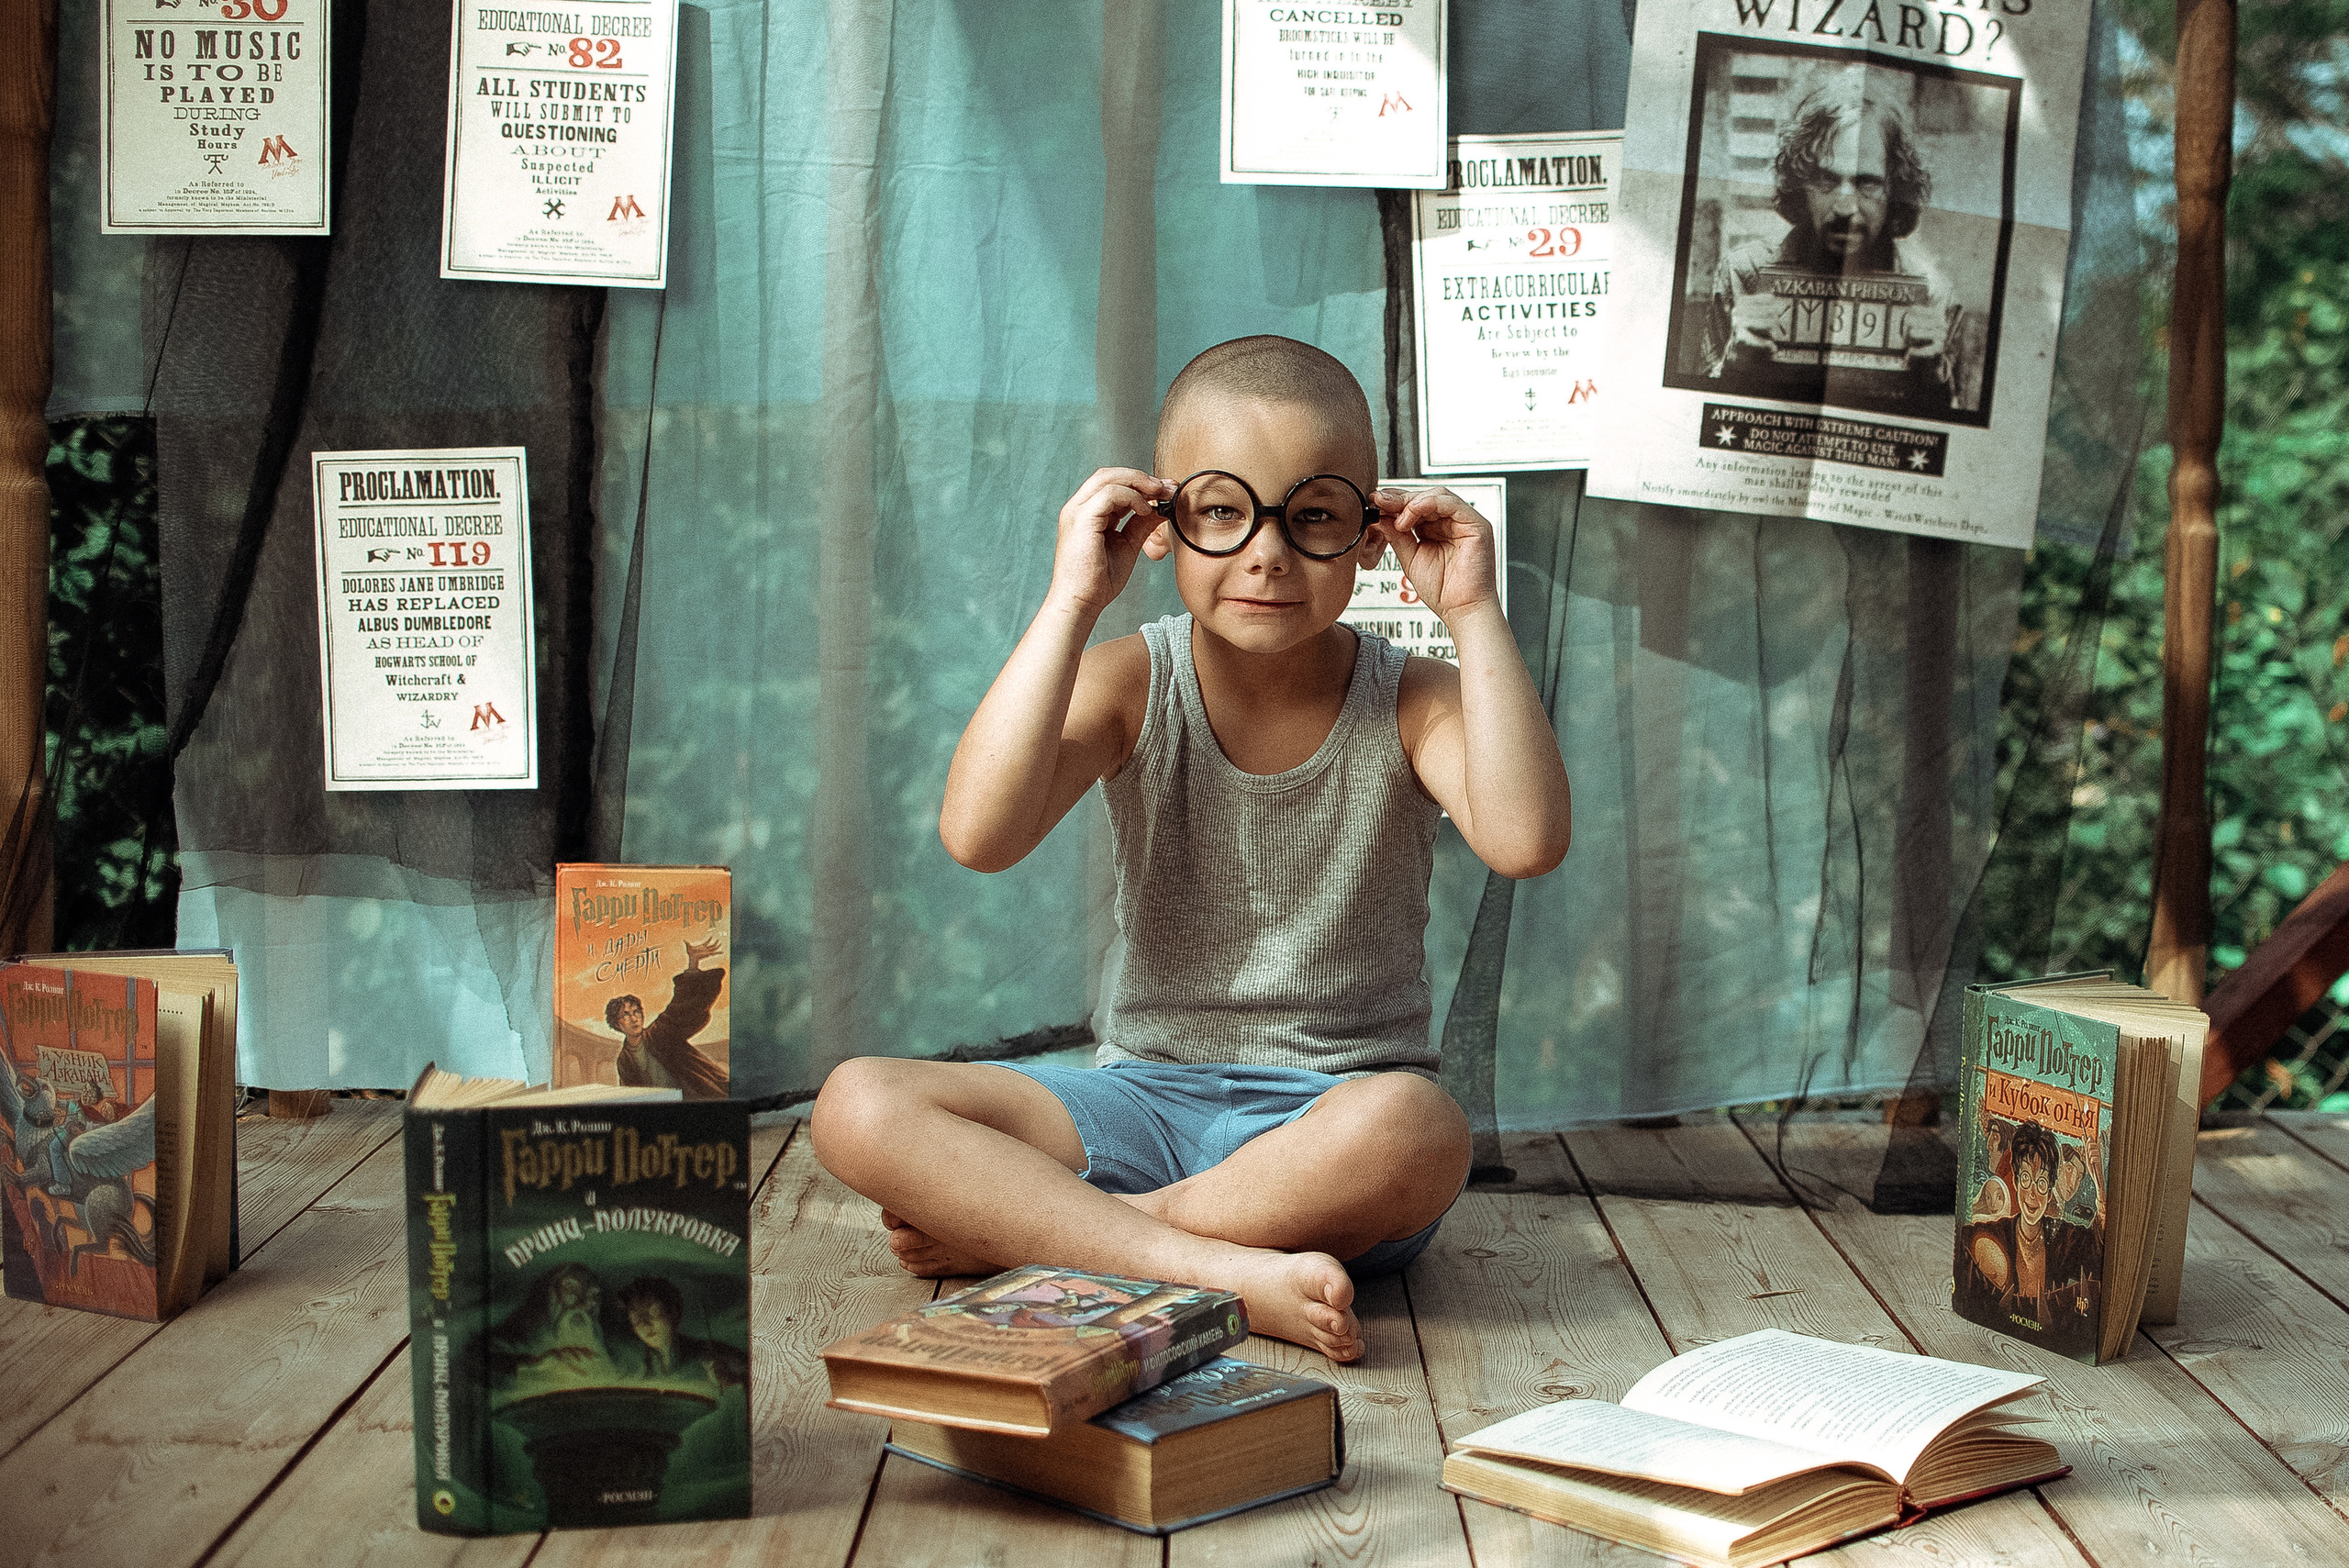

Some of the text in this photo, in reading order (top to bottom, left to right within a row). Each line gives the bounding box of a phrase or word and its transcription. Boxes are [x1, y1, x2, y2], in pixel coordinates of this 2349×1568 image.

[221, 0, 288, 21] 30
[1270, 8, 1404, 27] CANCELLED
[477, 9, 651, 38] EDUCATIONAL DECREE
[1733, 0, 2006, 61] WIZARD?
[135, 29, 300, 60] NO MUSIC
[1279, 29, 1348, 43] BROOMSTICKS
[1383, 32, 1395, 45] BE
[569, 37, 623, 69] 82
[143, 63, 283, 82] IS TO BE
[161, 86, 274, 104] PLAYED
[476, 77, 646, 103] ALL STUDENTS
[173, 107, 261, 120] DURING
[491, 101, 631, 124] WILL SUBMIT TO
[189, 123, 245, 139] Study
[501, 123, 617, 143] QUESTIONING
[197, 139, 237, 150] Hours
[510, 145, 607, 159] ABOUT
[521, 159, 594, 173] Suspected
[531, 175, 582, 185] ILLICIT
[1437, 203, 1609, 229] EDUCATIONAL DECREE
[1528, 228, 1582, 257] 29
[1774, 279, 1915, 302] AZKABAN PRISON
[1462, 302, 1597, 321] ACTIVITIES
[1508, 325, 1556, 342] Subject
[1564, 325, 1577, 337] to
[1711, 408, 1781, 427] APPROACH
[1784, 414, 1814, 429] WITH
[1817, 418, 1872, 438] EXTREME
[1743, 439, 1784, 454] MAGIC
[1786, 443, 1835, 460] AGAINST
[1835, 448, 1865, 463] THIS
[1750, 428, 1896, 457] DO NOT ATTEMPT TO USE
[339, 469, 501, 501] PROCLAMATION.
[1696, 458, 1943, 498] Any information leading to the arrest of this
[1642, 481, 1675, 496] Notify
[1677, 487, 1737, 503] immediately
[1744, 478, 1765, 486] man
[1769, 477, 1794, 489] shall
[1839, 488, 1891, 503] rewarded
[338, 514, 503, 539] EDUCATIONAL DECREE
[428, 541, 491, 566] 119
[342, 575, 505, 594] DOLORES JANE UMBRIDGE
[348, 596, 500, 612] HAS REPLACED
[358, 616, 492, 632] ALBUS DUMBLEDORE
[1409, 621, 1422, 639] TO
[366, 635, 484, 650] AS HEAD OF
[375, 654, 477, 668] HOGWARTS SCHOOL OF
[385, 674, 451, 686] Witchcraft
[396, 692, 459, 702] WIZARDRY
[571, 886, 723, 941] Гарри Поттер
[1987, 1014, 2103, 1094] Гарри Поттер
[1998, 1078, 2052, 1116] Кубок
[2054, 1101, 2096, 1129] огня
[501, 1129, 607, 1208] Гарри
[611, 1126, 738, 1189] Поттер
